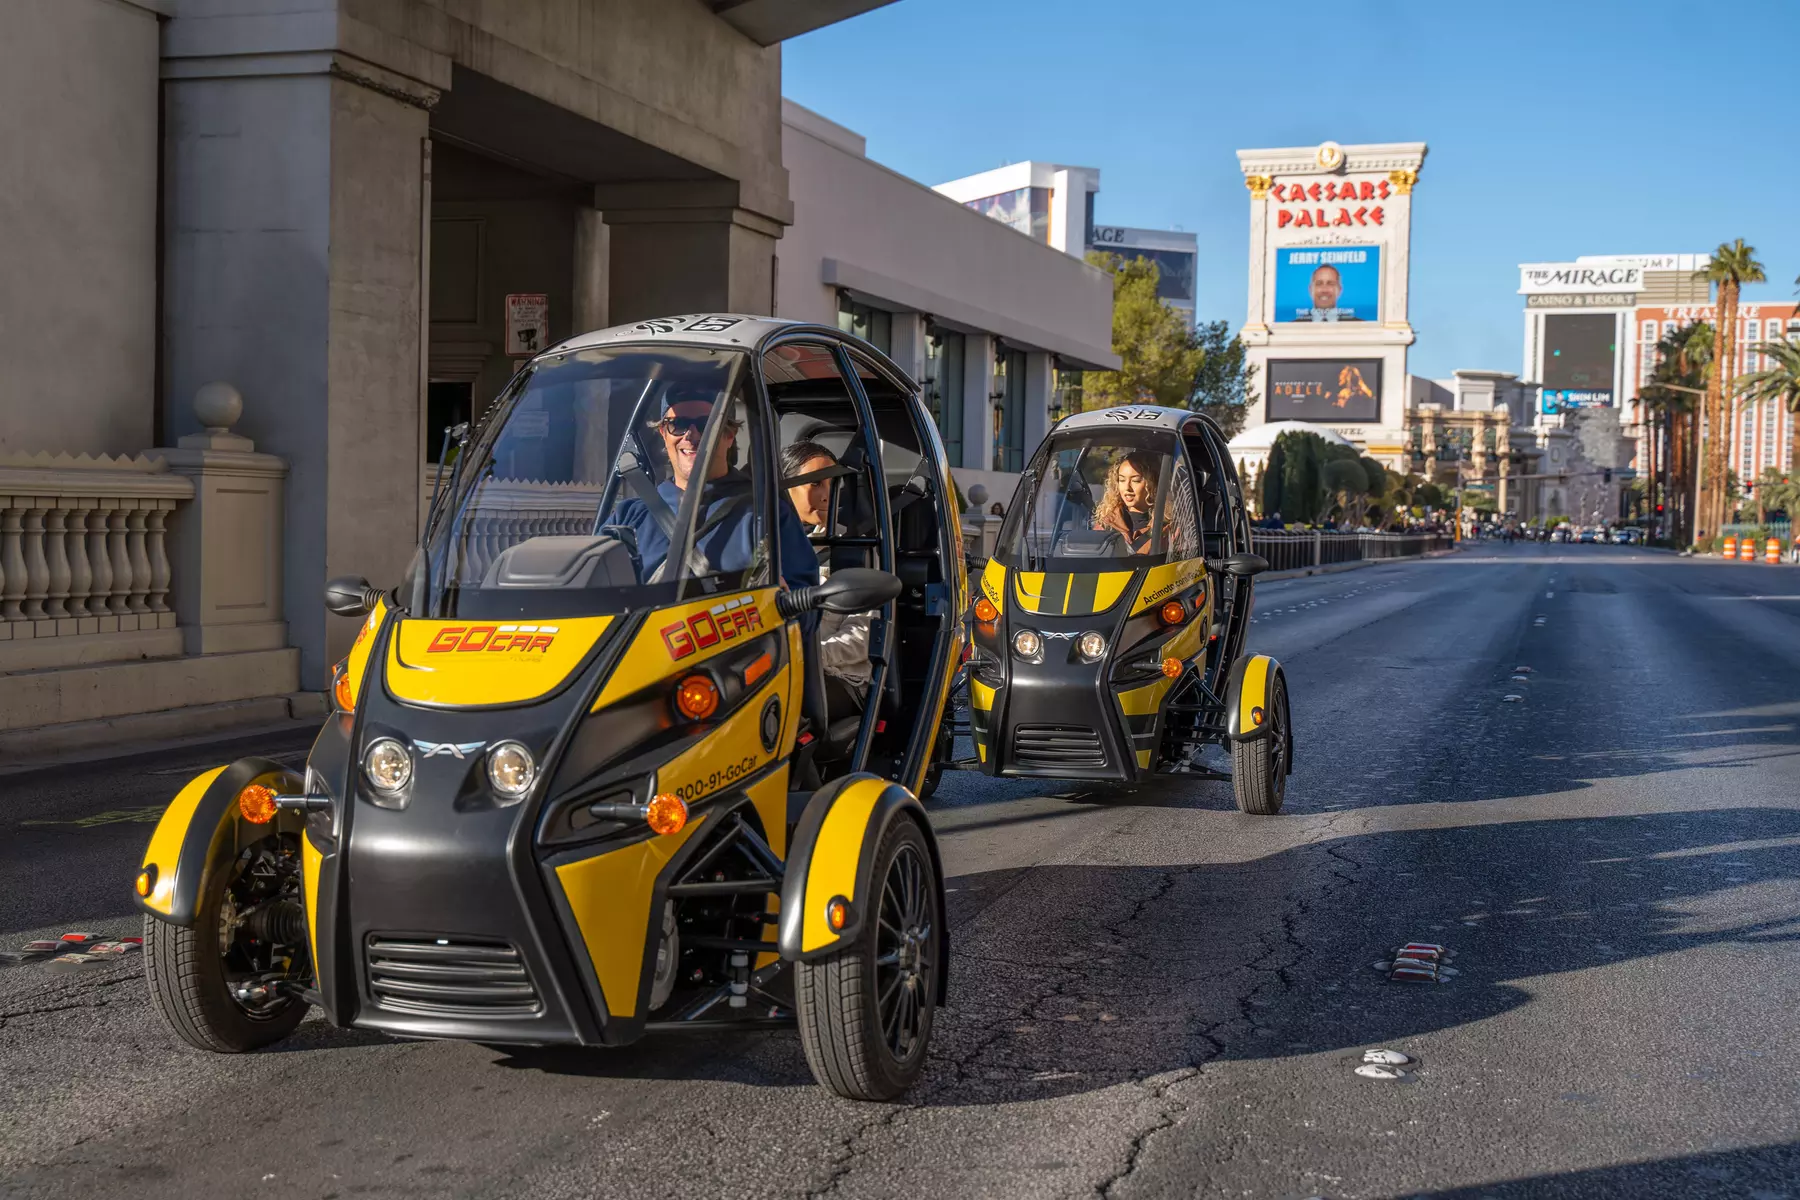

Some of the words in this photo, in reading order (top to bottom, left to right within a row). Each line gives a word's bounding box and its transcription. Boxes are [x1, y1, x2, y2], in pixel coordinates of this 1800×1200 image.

[1272, 180, 1391, 203] CAESARS
[1278, 206, 1384, 228] PALACE
[1289, 253, 1320, 264] JERRY
[1320, 251, 1367, 264] SEINFELD
[1615, 258, 1674, 268] UMP
[1526, 270, 1549, 279] THE
[1536, 268, 1639, 286] MIRAGE
[511, 296, 545, 306] WARNING
[1528, 295, 1571, 306] CASINO
[1573, 295, 1582, 305] &
[1585, 294, 1635, 305] RESORT
[1664, 306, 1760, 320] TREASRE
[1567, 392, 1592, 402] SHIN
[1592, 392, 1611, 402] LIM
[427, 626, 554, 653] GOCAR
[659, 605, 764, 661] GOCAR
[676, 755, 758, 801] 800-91-GoCar
